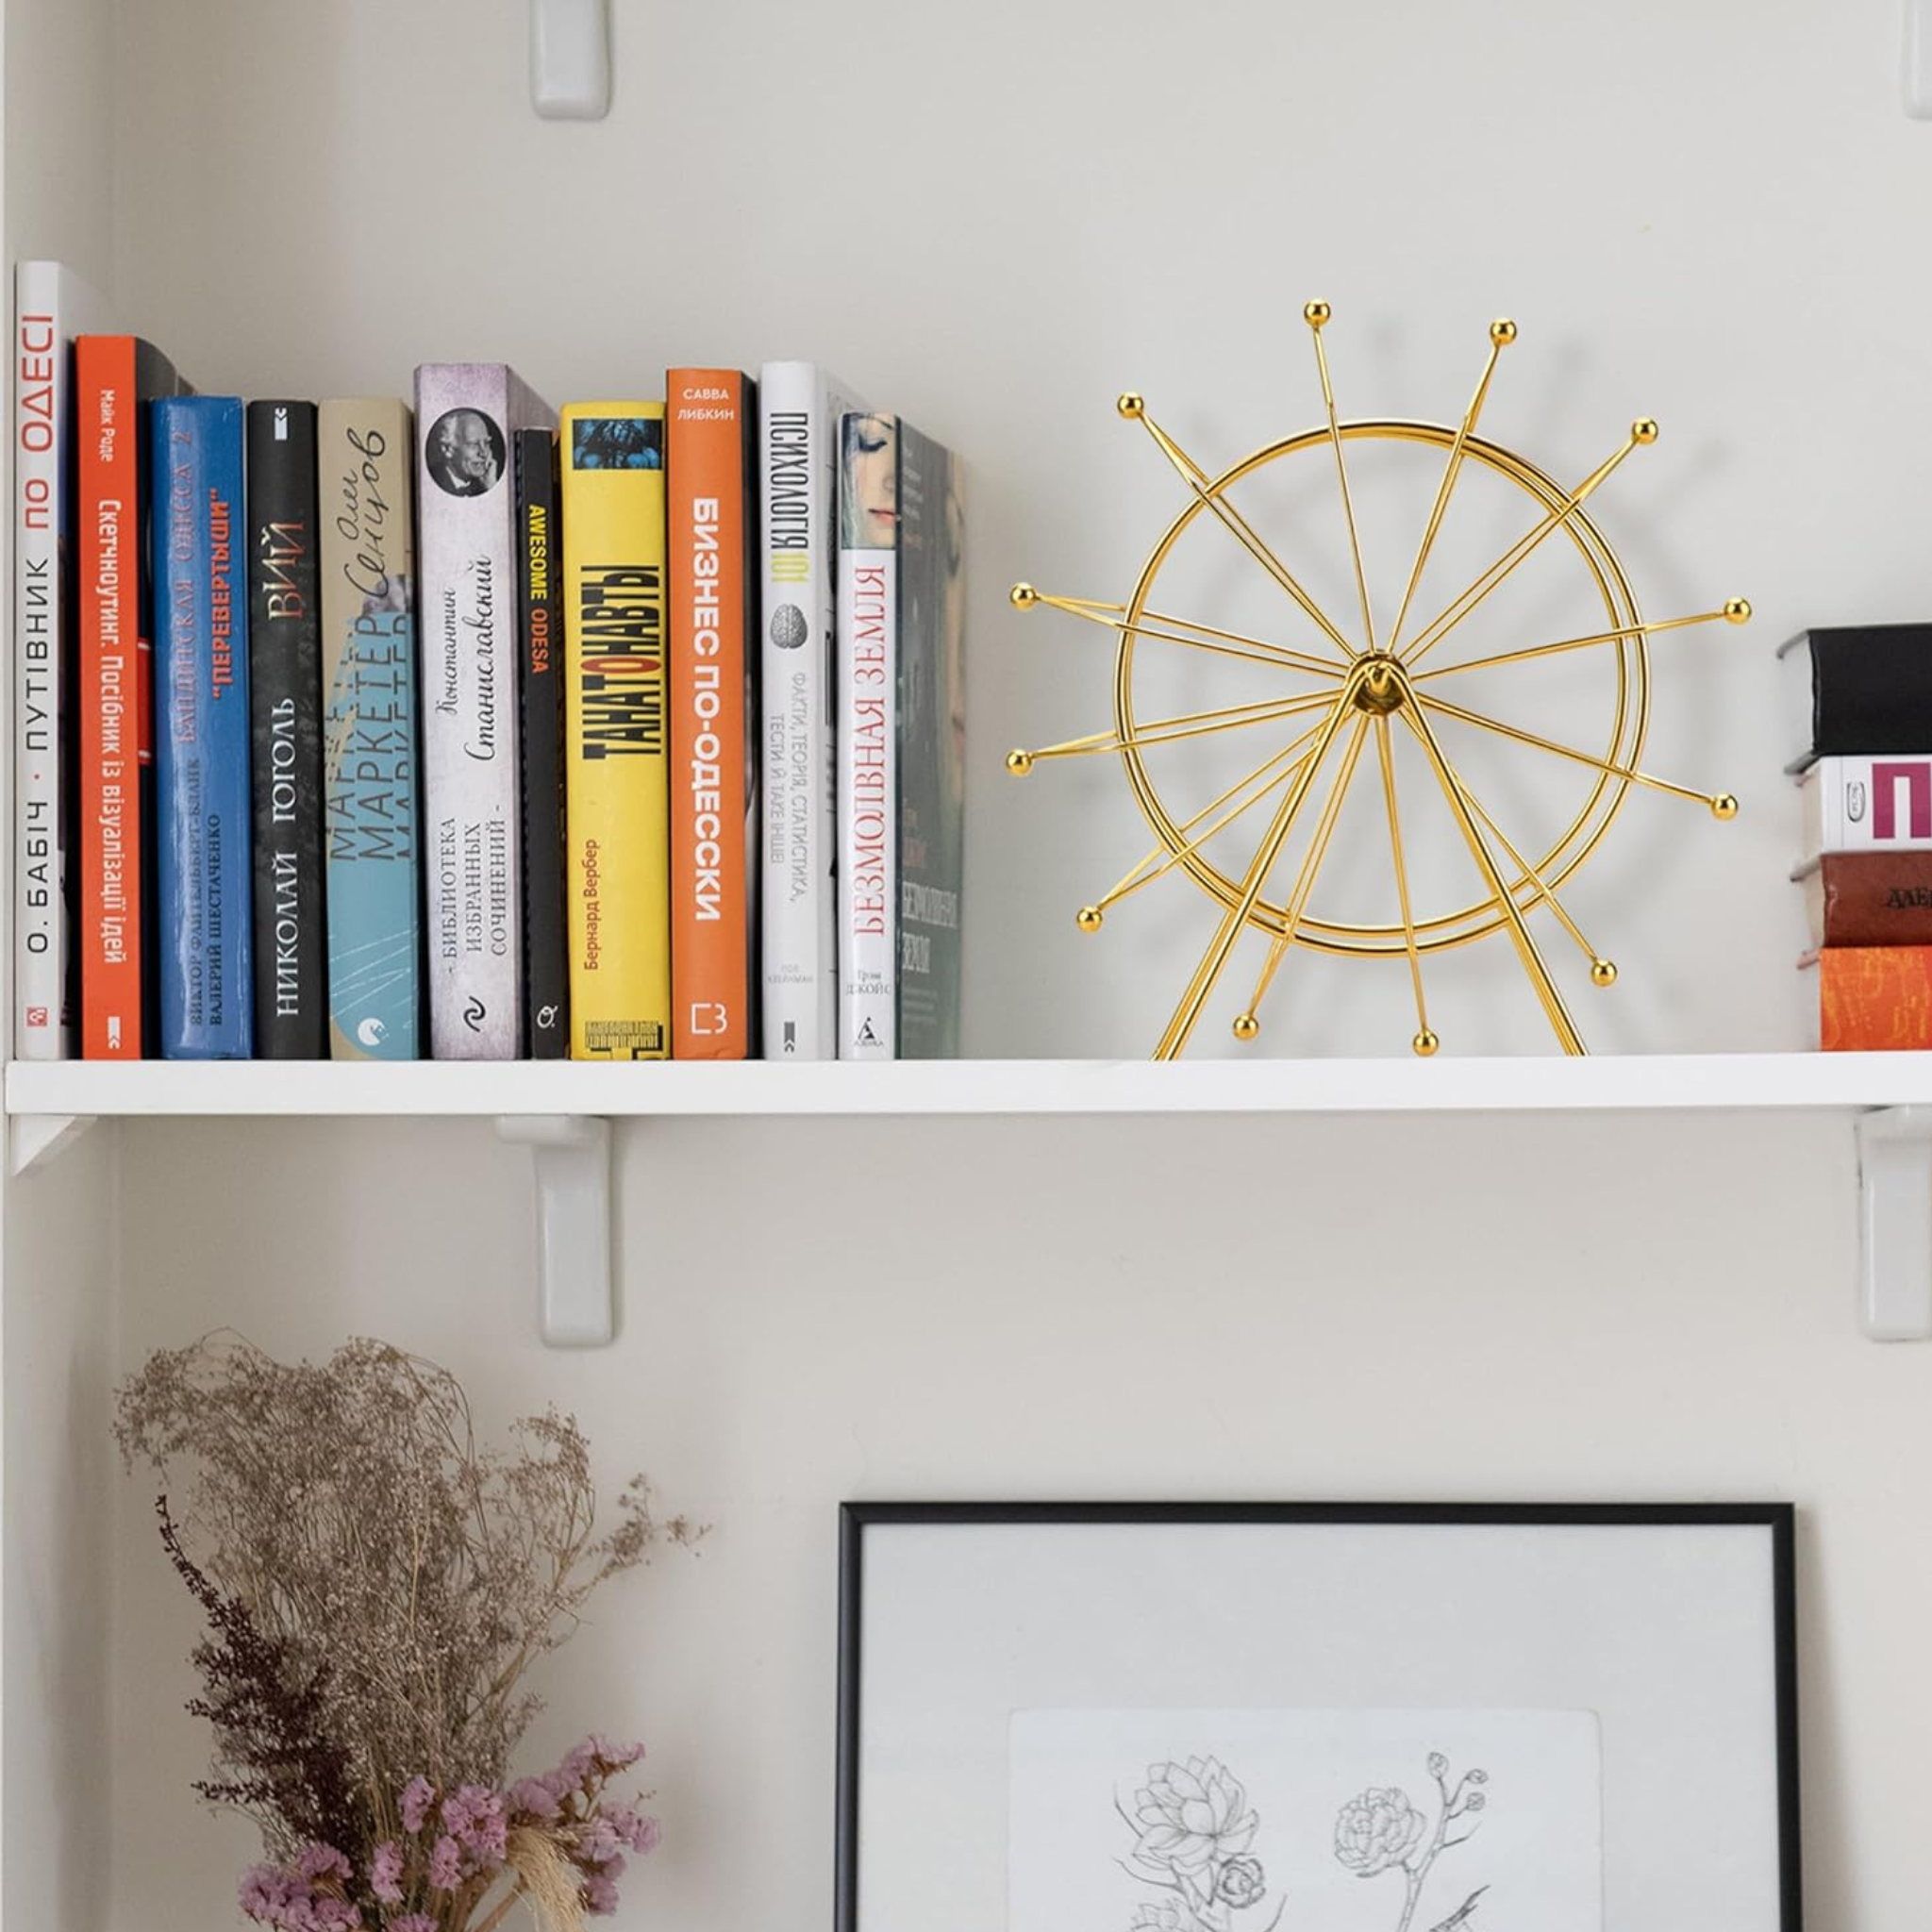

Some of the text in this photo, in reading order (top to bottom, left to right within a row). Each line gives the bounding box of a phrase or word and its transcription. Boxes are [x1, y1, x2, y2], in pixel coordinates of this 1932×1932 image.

[99, 390, 115, 462] Майк Роде
[171, 429, 192, 445] 2
[677, 408, 735, 421] ЛИБКИН
[683, 388, 730, 400] САВВА
[261, 522, 304, 620] ВИЙ
[343, 427, 390, 599] Сенцов
[770, 412, 810, 583] ПСИХОЛОГІЯ 101
[22, 316, 53, 954] О. БАБІЧ ПУТІВНИК ПО ОДЕСІ
[435, 589, 458, 716] Константин
[461, 554, 495, 762] Станиславский
[528, 505, 549, 673] AWESOME ODESA
[580, 565, 661, 760] ТАНАТОНАВТЫ
[95, 499, 127, 964] Скетчноутинг. Посібник із візуалізації ідей
[355, 614, 394, 862] МАРКЕТЕР
[691, 498, 722, 921] БИЗНЕС ПО-ОДЕССКИ
[770, 713, 785, 761] ТЕСТИ
[790, 672, 808, 903] ФАКТИ, ТЕОРІЯ, СТАТИСТИКА,
[854, 566, 886, 938] БЕЗМОЛВНАЯ ЗЕМЛЯ
[272, 697, 298, 1018] НИКОЛАЙ ГОГОЛЬ
[771, 784, 786, 819] ТАКЕ
[206, 814, 223, 1025] ВАЛЕРИЙ ШЕСТАЧЕНКО
[441, 818, 458, 959] БИБЛИОТЕКА
[465, 823, 483, 953] ИЗБРАННЫХ
[486, 820, 508, 957] СОЧИНЕНИЙ
[581, 839, 602, 971] Бернард Вербер
